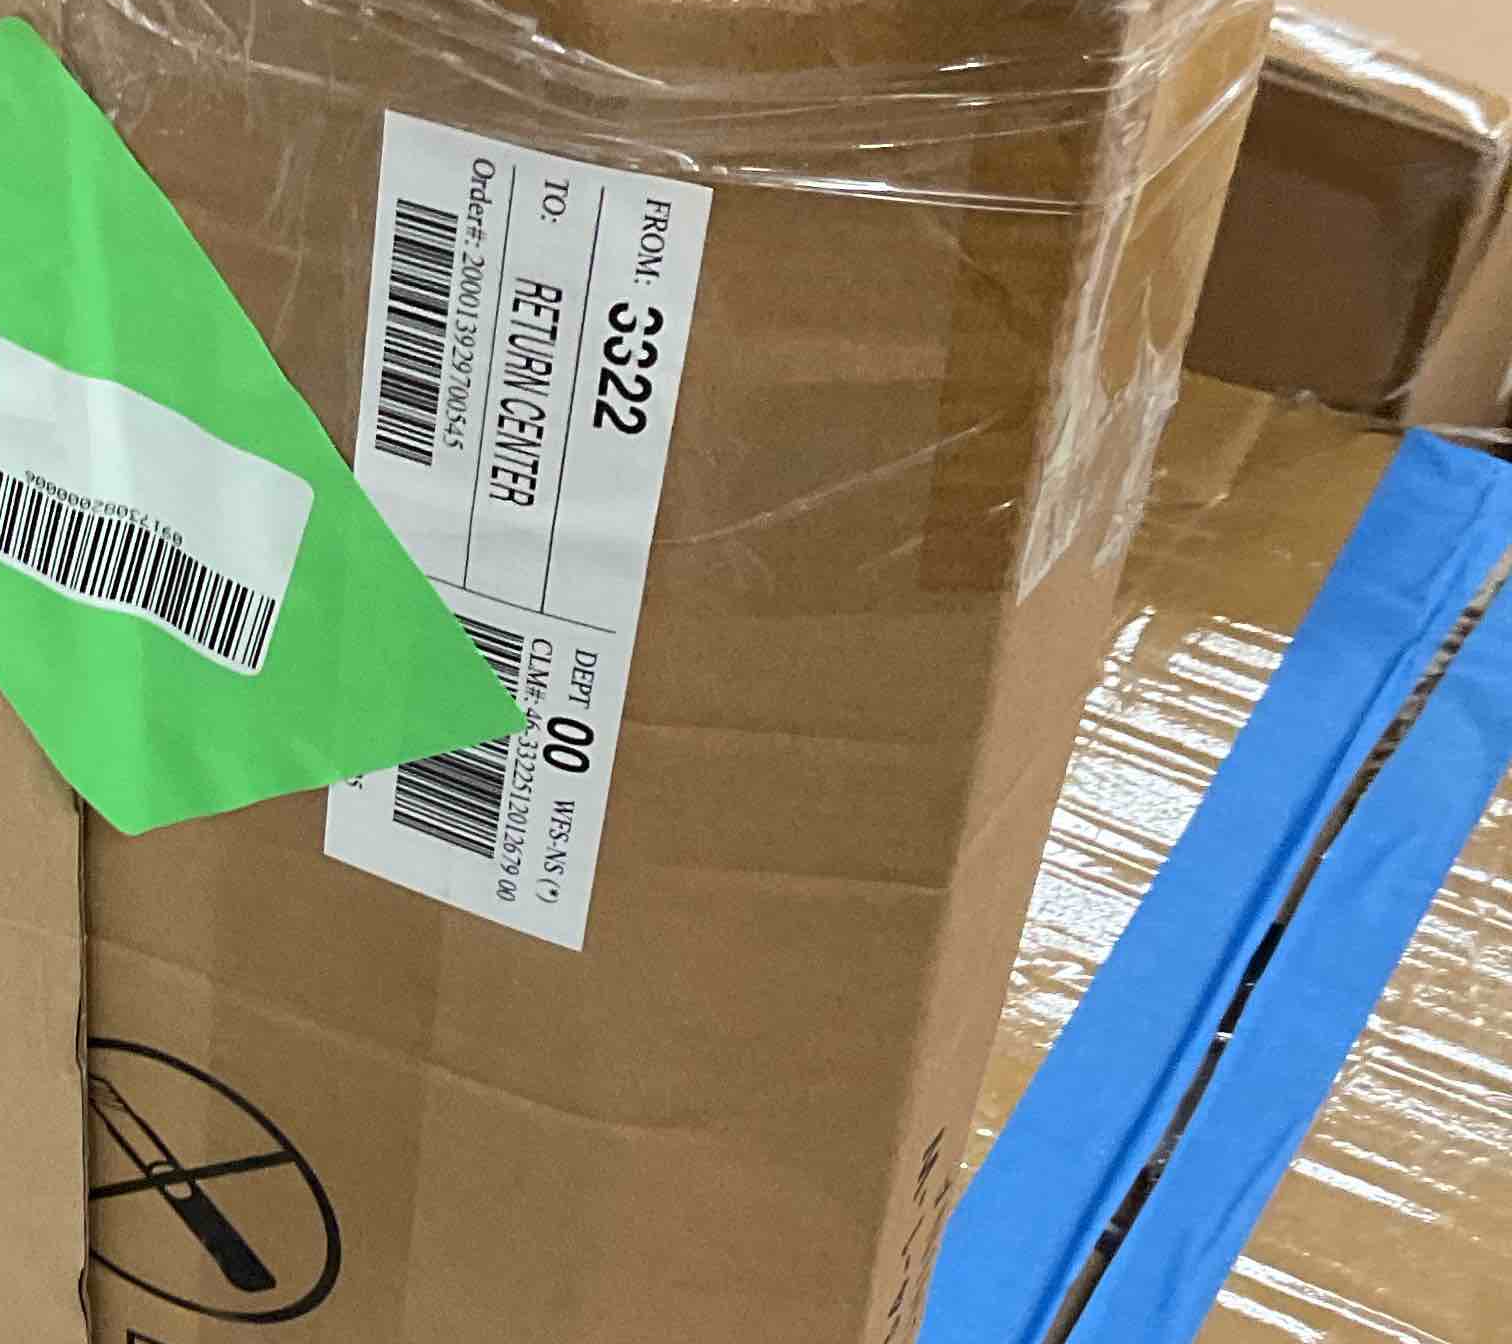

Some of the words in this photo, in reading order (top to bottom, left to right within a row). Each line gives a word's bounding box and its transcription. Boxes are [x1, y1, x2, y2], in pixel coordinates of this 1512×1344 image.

[464, 157, 496, 248] Order#:
[540, 177, 570, 224] TO:
[633, 197, 672, 288] FROM:
[441, 251, 486, 452] 200013929700545
[503, 277, 563, 397] RETURN
[593, 301, 664, 435] 3322
[488, 398, 546, 507] CENTER
[24, 470, 183, 547] 09173082000006
[523, 638, 553, 705] CLM#:
[568, 648, 599, 710] DEPT
[542, 716, 595, 773] 00
[543, 800, 576, 875] WFS-NS
